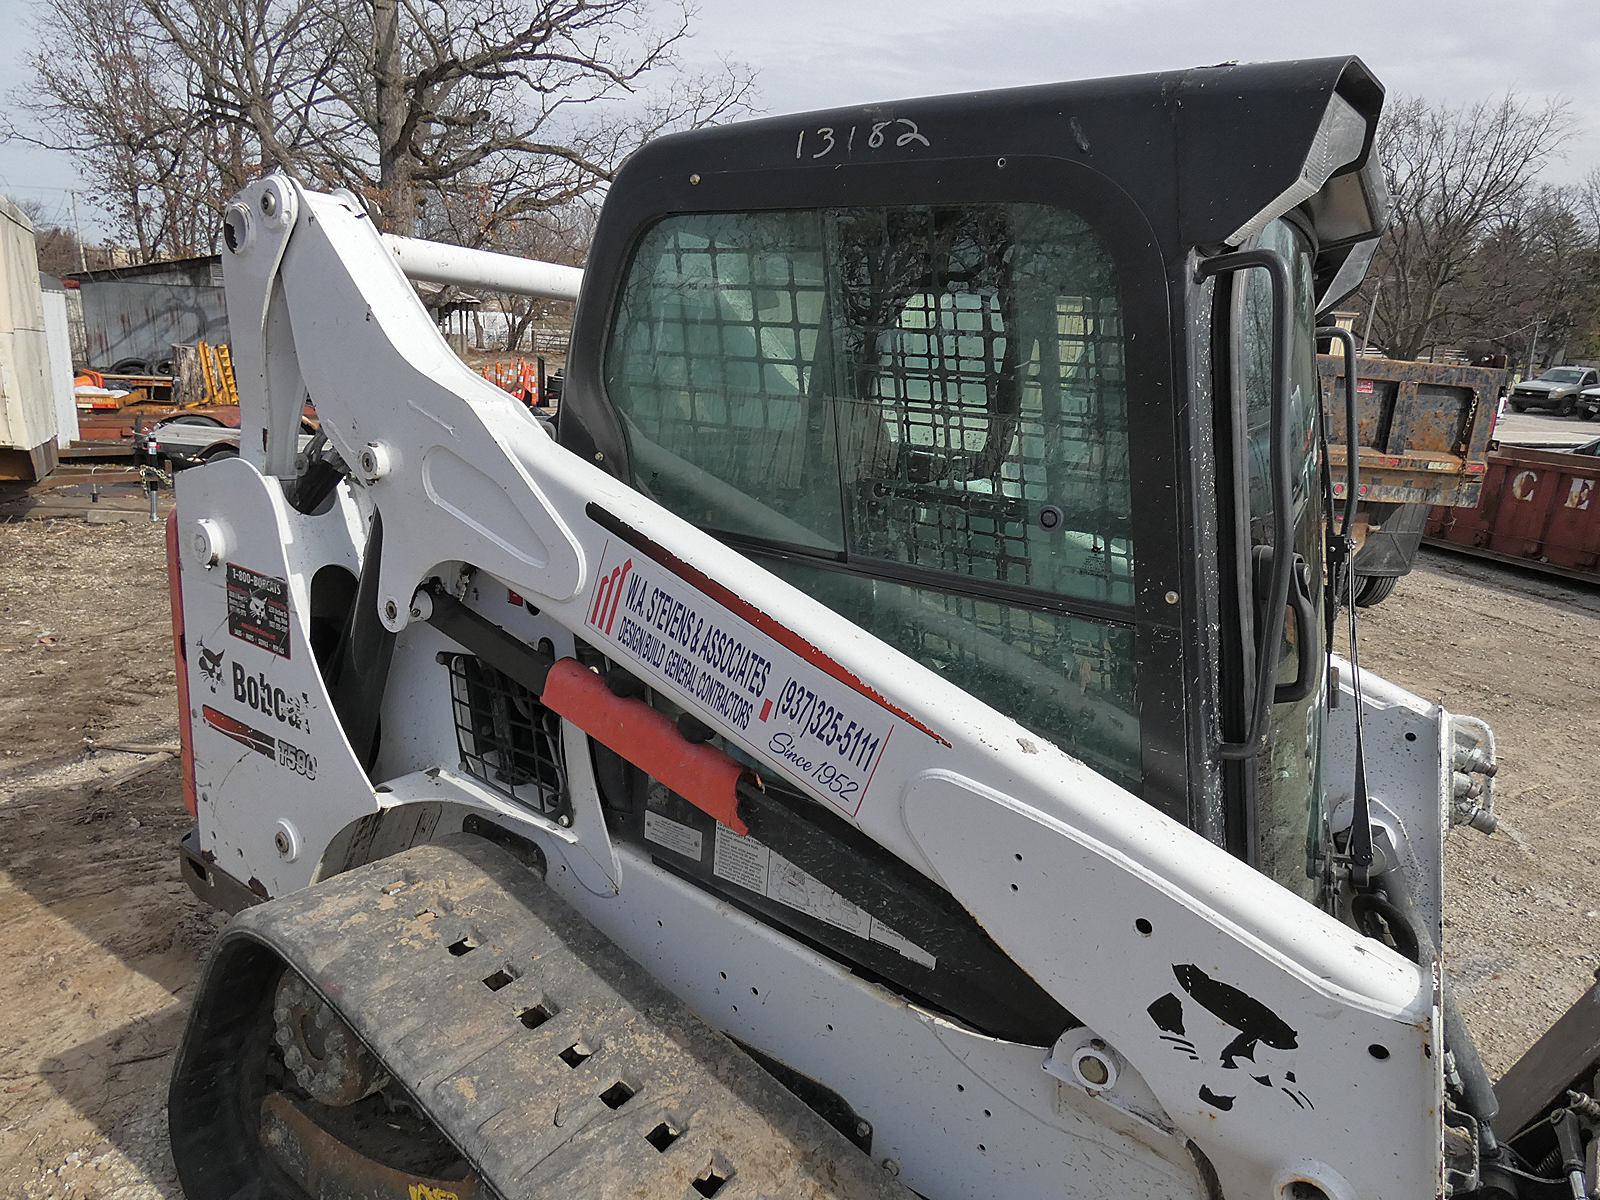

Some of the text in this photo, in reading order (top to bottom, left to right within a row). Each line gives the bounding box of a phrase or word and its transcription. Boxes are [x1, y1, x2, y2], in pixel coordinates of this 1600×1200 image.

[796, 118, 930, 159] 13182
[617, 616, 754, 731] DESIGN/BUILD GENERAL CONTRACTORS
[625, 572, 772, 698] W.A. STEVENS & ASSOCIATES
[768, 732, 859, 802] Since 1952
[774, 676, 880, 773] (937)325-5111
